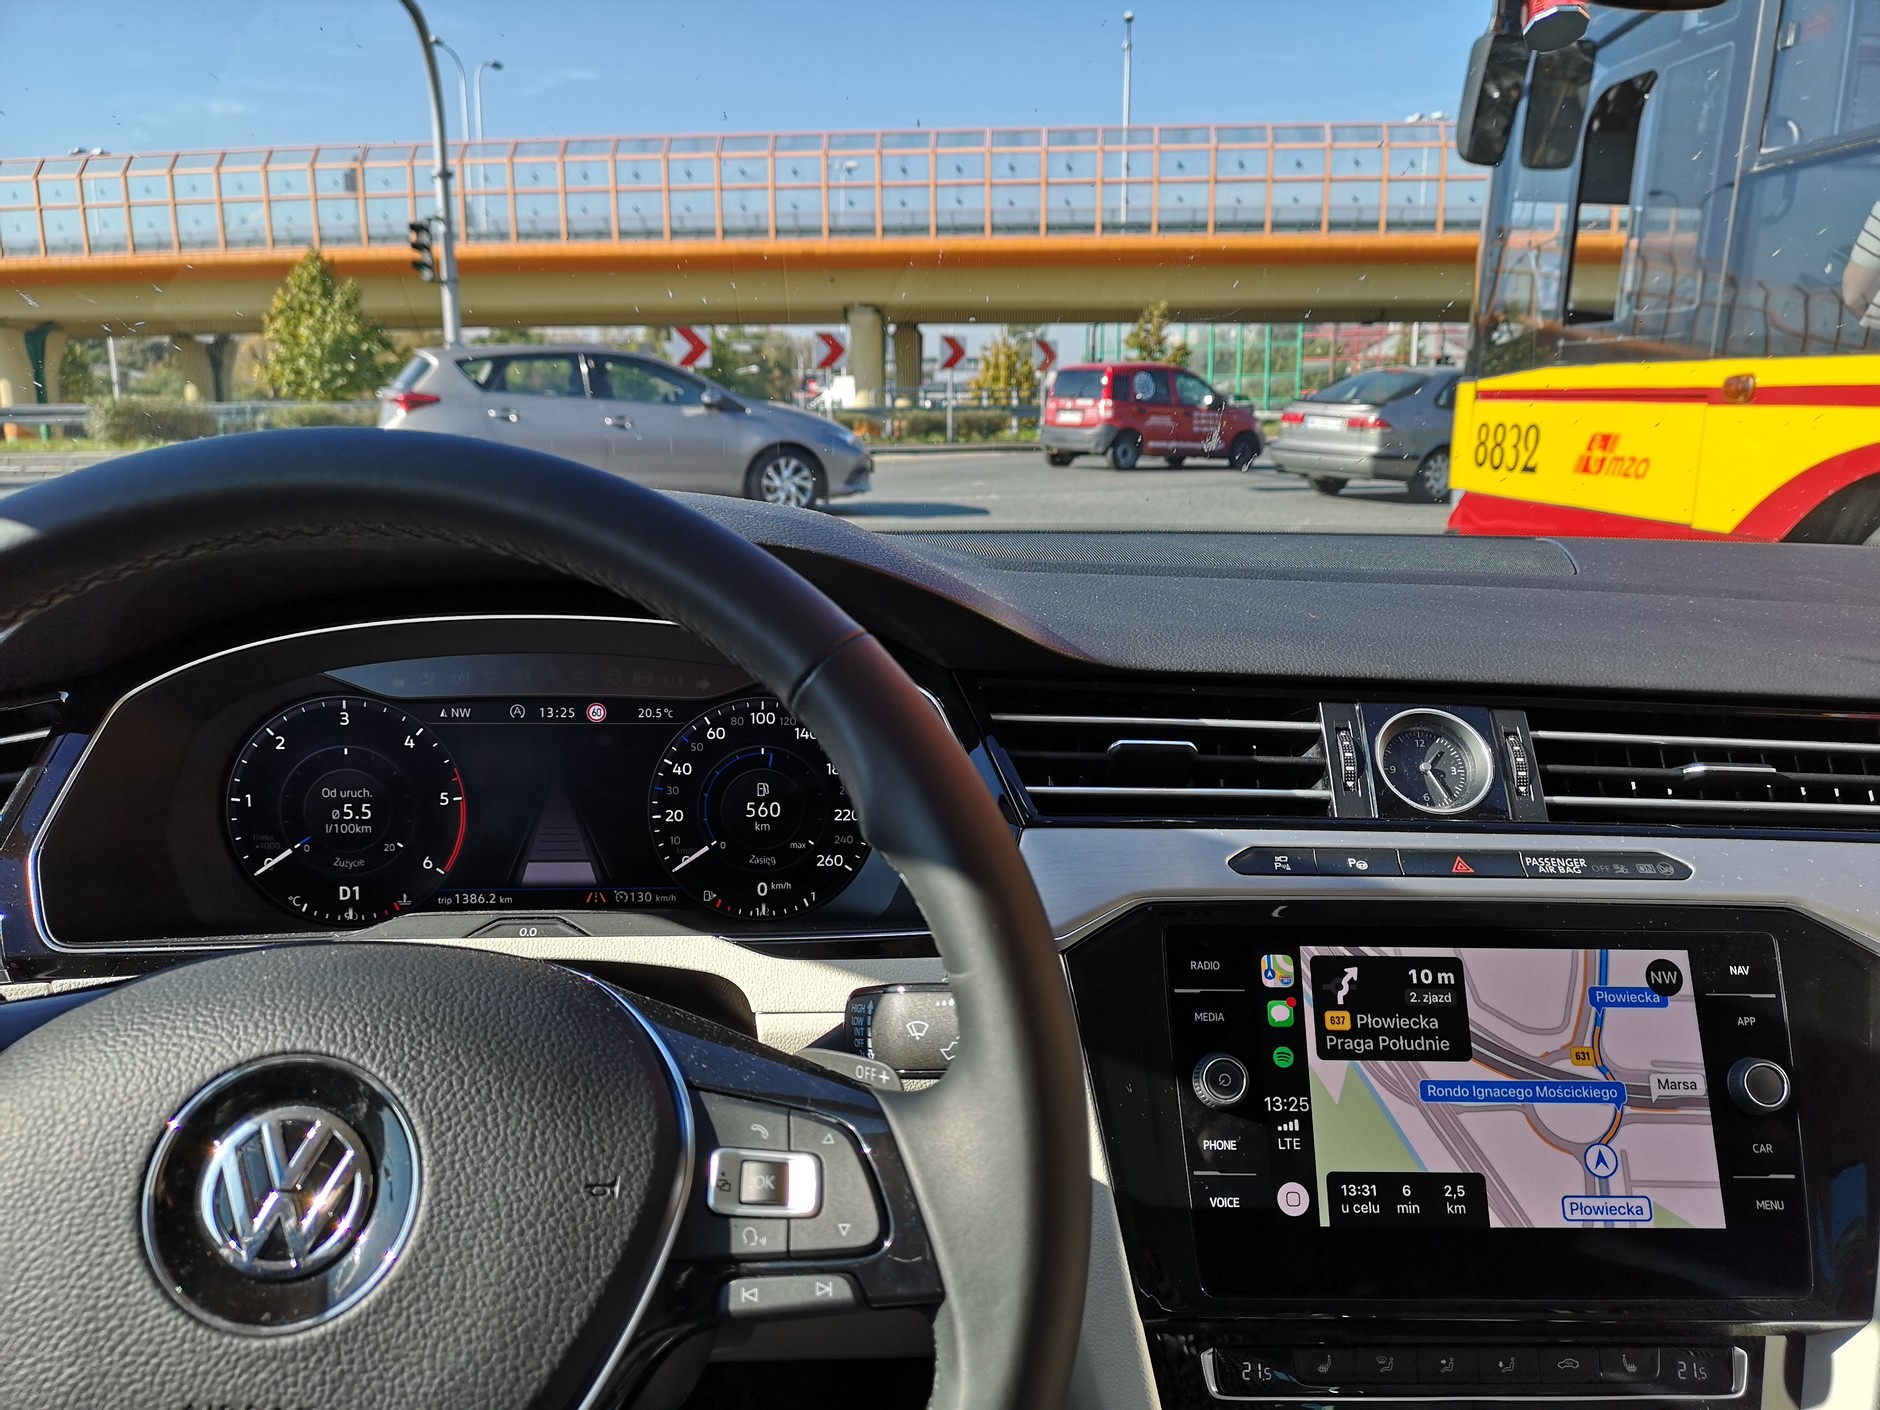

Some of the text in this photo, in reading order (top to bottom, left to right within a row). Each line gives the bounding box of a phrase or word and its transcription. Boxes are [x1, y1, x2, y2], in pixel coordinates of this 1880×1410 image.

[1474, 422, 1540, 474] 8832
[451, 708, 471, 718] NW
[539, 707, 576, 718] 13:25
[591, 708, 602, 717] 60
[339, 712, 349, 725] 3
[730, 716, 744, 726] 80
[750, 712, 776, 725] 100
[779, 716, 797, 726] 120
[706, 727, 726, 740] 60
[275, 736, 285, 750] 2
[404, 735, 415, 749] 4
[690, 742, 704, 752] 50
[1415, 739, 1426, 748] 12
[672, 763, 692, 775] 40
[1389, 765, 1396, 774] 9
[1450, 766, 1457, 776] 3
[321, 787, 373, 798] Od uruch.
[666, 785, 679, 795] 30
[245, 794, 251, 807] 1
[439, 793, 449, 805] 5
[1422, 793, 1430, 802] 6
[343, 803, 372, 820] 5.5
[745, 801, 781, 818] 560
[665, 809, 684, 822] 20
[754, 821, 771, 831] km
[669, 836, 681, 845] 10
[834, 835, 854, 844] 240
[303, 844, 310, 853] 0
[384, 843, 396, 852] 20
[720, 841, 726, 850] 0
[333, 857, 366, 870] Zużycie
[422, 856, 433, 869] 6
[748, 854, 777, 867] Zasięg
[816, 854, 844, 867] 260
[1525, 857, 1588, 868] PASSENGER
[1538, 865, 1582, 874] AIR BAG
[1591, 864, 1611, 873] OFF
[338, 885, 360, 900] D1
[756, 881, 792, 897] 0 km/h
[438, 893, 513, 905] trip 1386.2 km
[630, 892, 677, 902] 130 km/h
[811, 891, 816, 901] 1
[519, 927, 538, 937] 0.0
[1190, 960, 1221, 971] RADIO
[1729, 965, 1750, 976] NAV
[1408, 969, 1455, 985] 10 m
[1650, 970, 1677, 985] NW
[1409, 991, 1452, 1005] 2. zjazd
[1595, 990, 1661, 1004] Płowiecka
[850, 1003, 866, 1013] HIGH
[851, 1016, 865, 1026] LOW
[1194, 1012, 1225, 1022] MEDIA
[1329, 1014, 1439, 1030] 637 Płowiecka
[1737, 1016, 1756, 1026] APP
[853, 1027, 865, 1037] INT
[853, 1038, 865, 1048] OFF
[1326, 1035, 1450, 1054] Praga Południe
[1575, 1051, 1591, 1061] 631
[855, 1065, 878, 1082] OFF
[1657, 1078, 1698, 1091] Marsa
[1427, 1085, 1619, 1101] Rondo Ignacego Mościckiego
[1264, 1096, 1310, 1113] 13:25
[1203, 1139, 1237, 1150] PHONE
[1278, 1138, 1301, 1150] LTE
[1752, 1143, 1774, 1154] CAR
[754, 1174, 776, 1190] OK
[1340, 1184, 1466, 1199] 13:31 6 2,5
[1209, 1197, 1241, 1208] VOICE
[1756, 1200, 1785, 1211] MENU
[1341, 1202, 1467, 1215] u celu min km
[1570, 1201, 1645, 1217] Płowiecka
[1242, 1361, 1272, 1381] 21.5
[1677, 1361, 1708, 1380] 21.5
